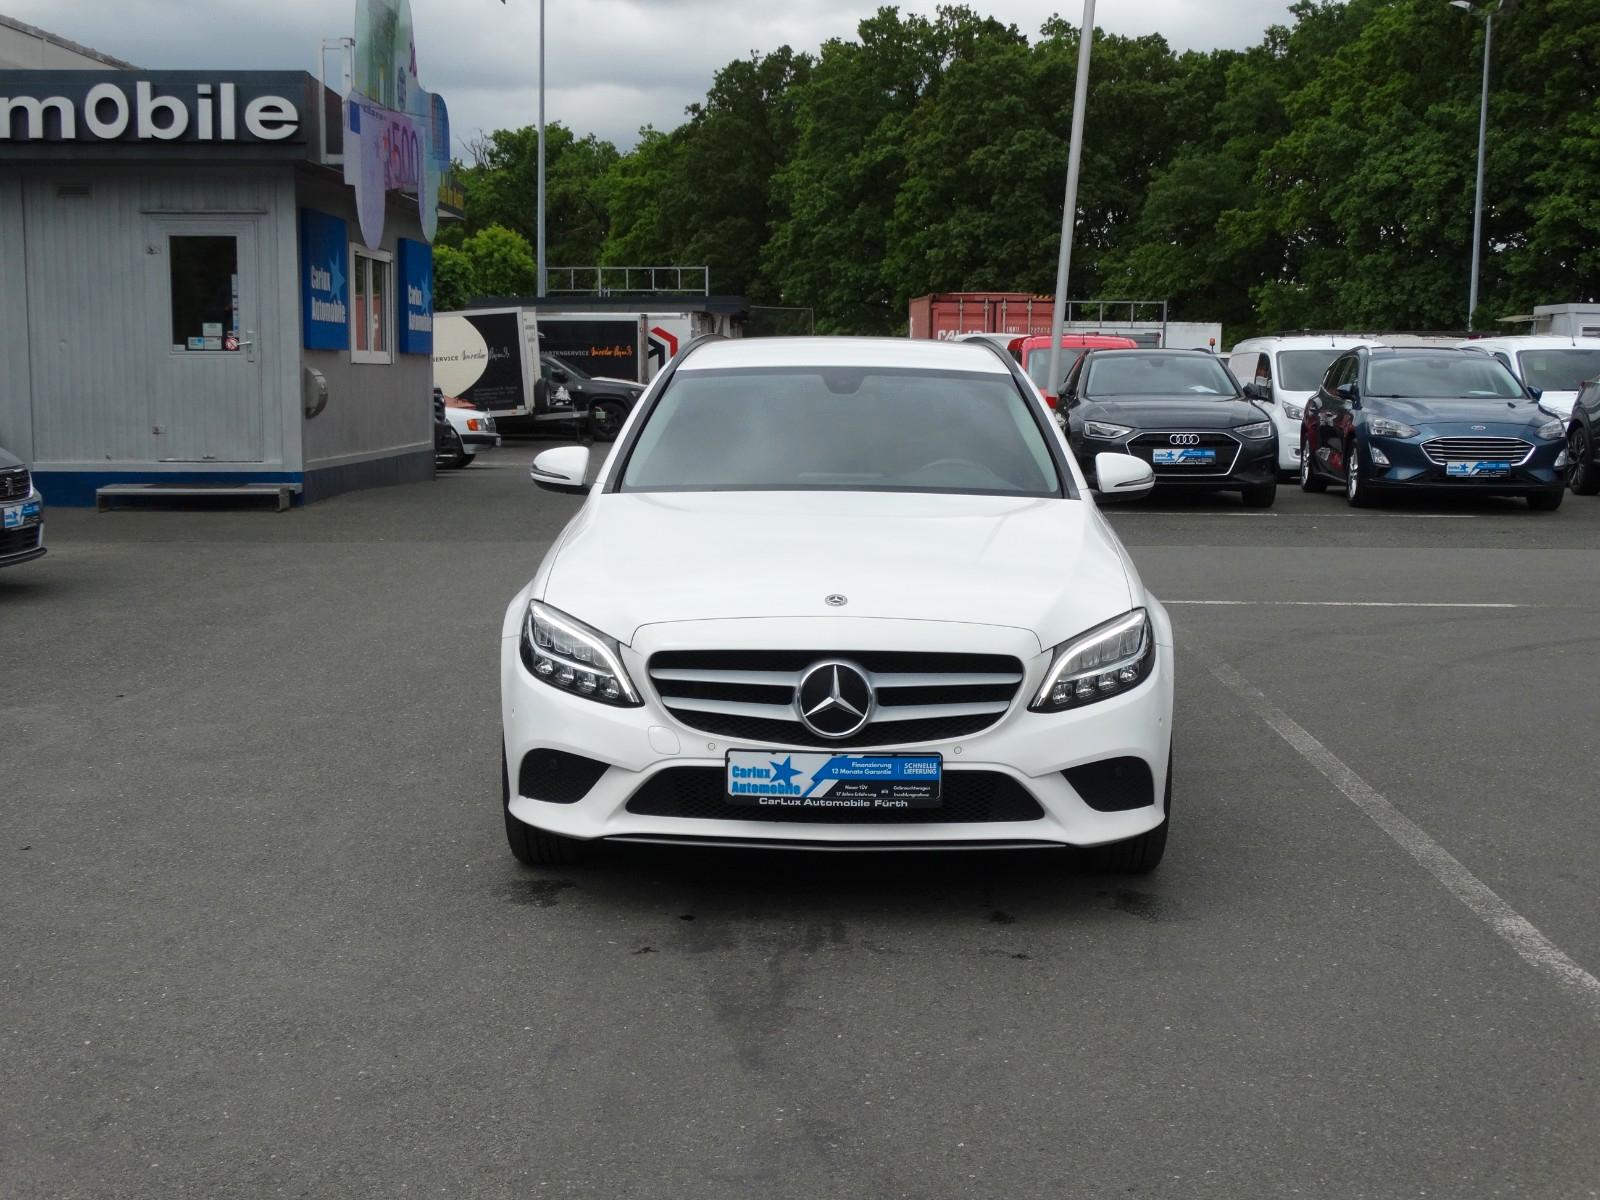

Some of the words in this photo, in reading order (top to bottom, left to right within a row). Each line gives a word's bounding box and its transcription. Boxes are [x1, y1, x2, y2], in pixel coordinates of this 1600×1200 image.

[311, 296, 346, 324] Automobile
[731, 765, 771, 779] Carlux
[731, 781, 801, 795] Automobile
[759, 797, 801, 806] CarLux
[803, 798, 871, 808] Automobile
[874, 799, 908, 808] Fürth
